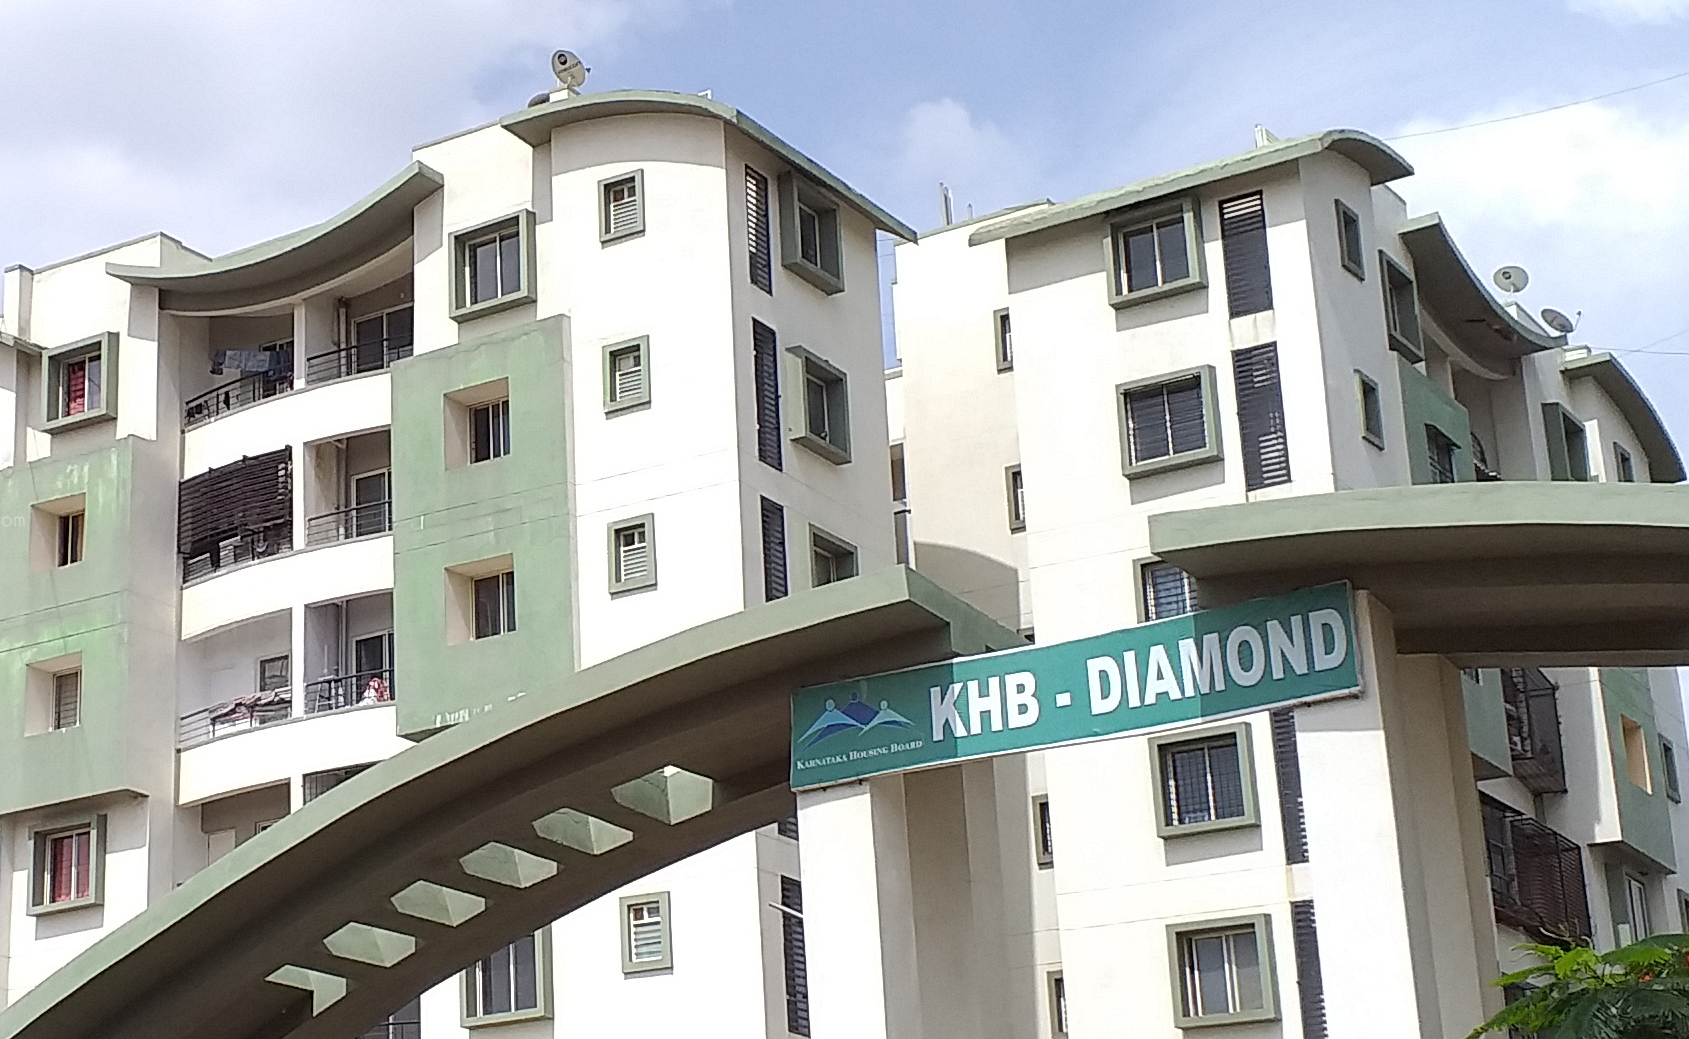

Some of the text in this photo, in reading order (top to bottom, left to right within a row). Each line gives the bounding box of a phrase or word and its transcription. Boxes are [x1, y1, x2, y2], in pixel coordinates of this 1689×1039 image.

[929, 607, 1348, 742] KHB - DIAMOND
[849, 746, 889, 761] HOUSING
[890, 740, 924, 753] BOARD
